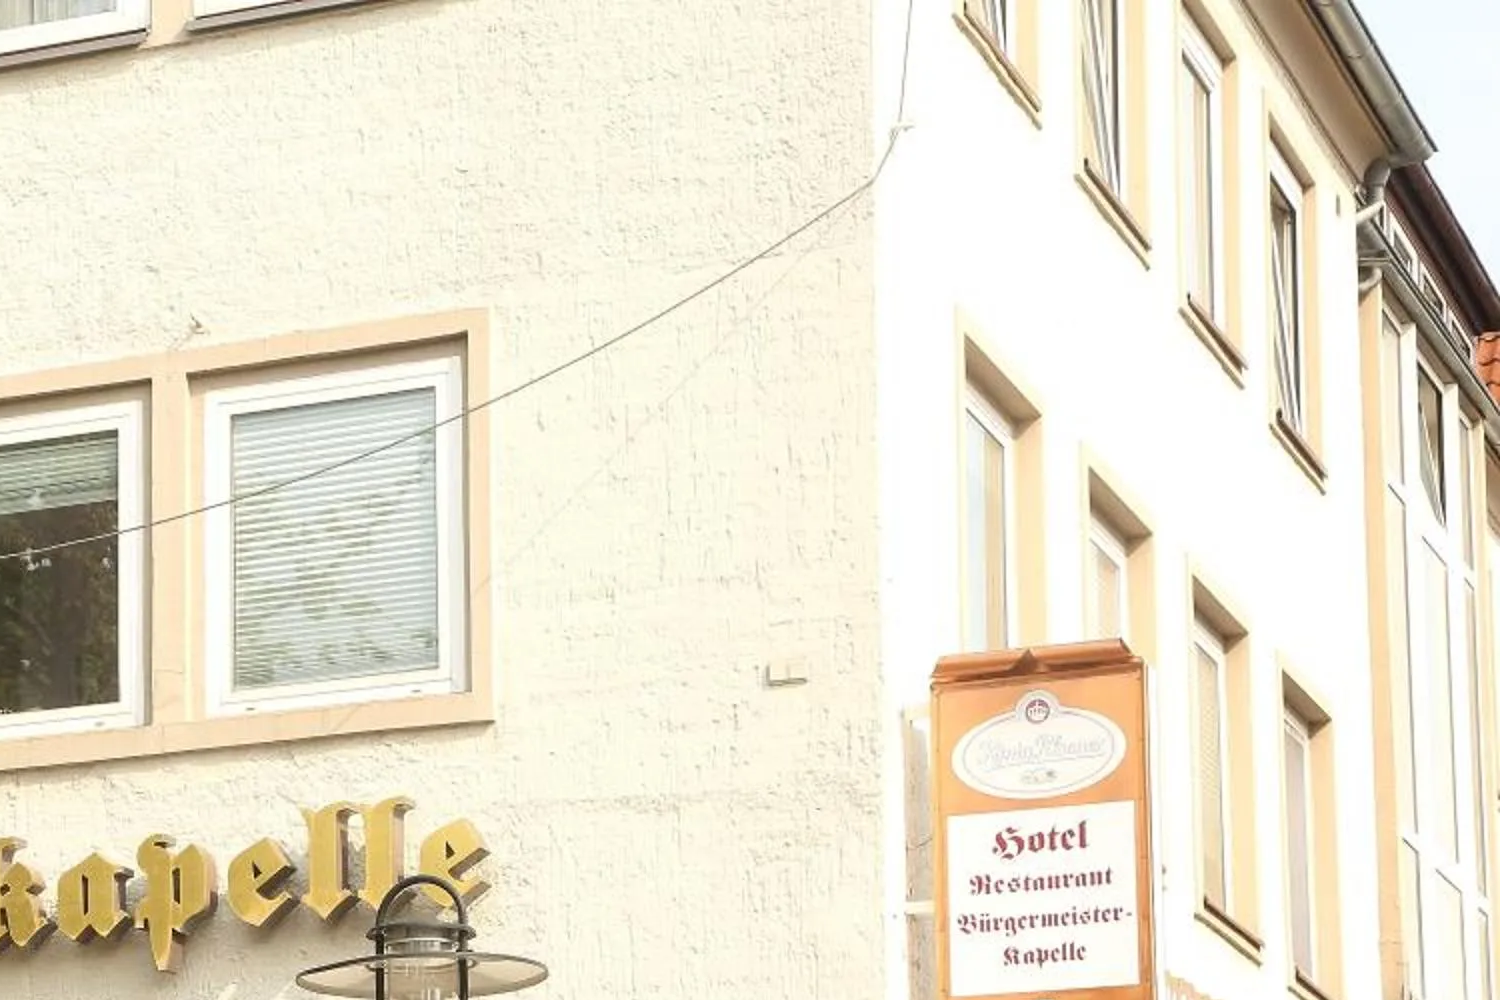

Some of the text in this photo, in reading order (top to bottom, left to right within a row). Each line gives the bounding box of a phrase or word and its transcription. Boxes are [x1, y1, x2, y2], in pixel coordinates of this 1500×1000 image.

[992, 820, 1088, 860] Hotel
[969, 866, 1113, 896] Restaurant
[957, 906, 1132, 937] Bürgermeister-
[1003, 941, 1086, 968] Kapelle
